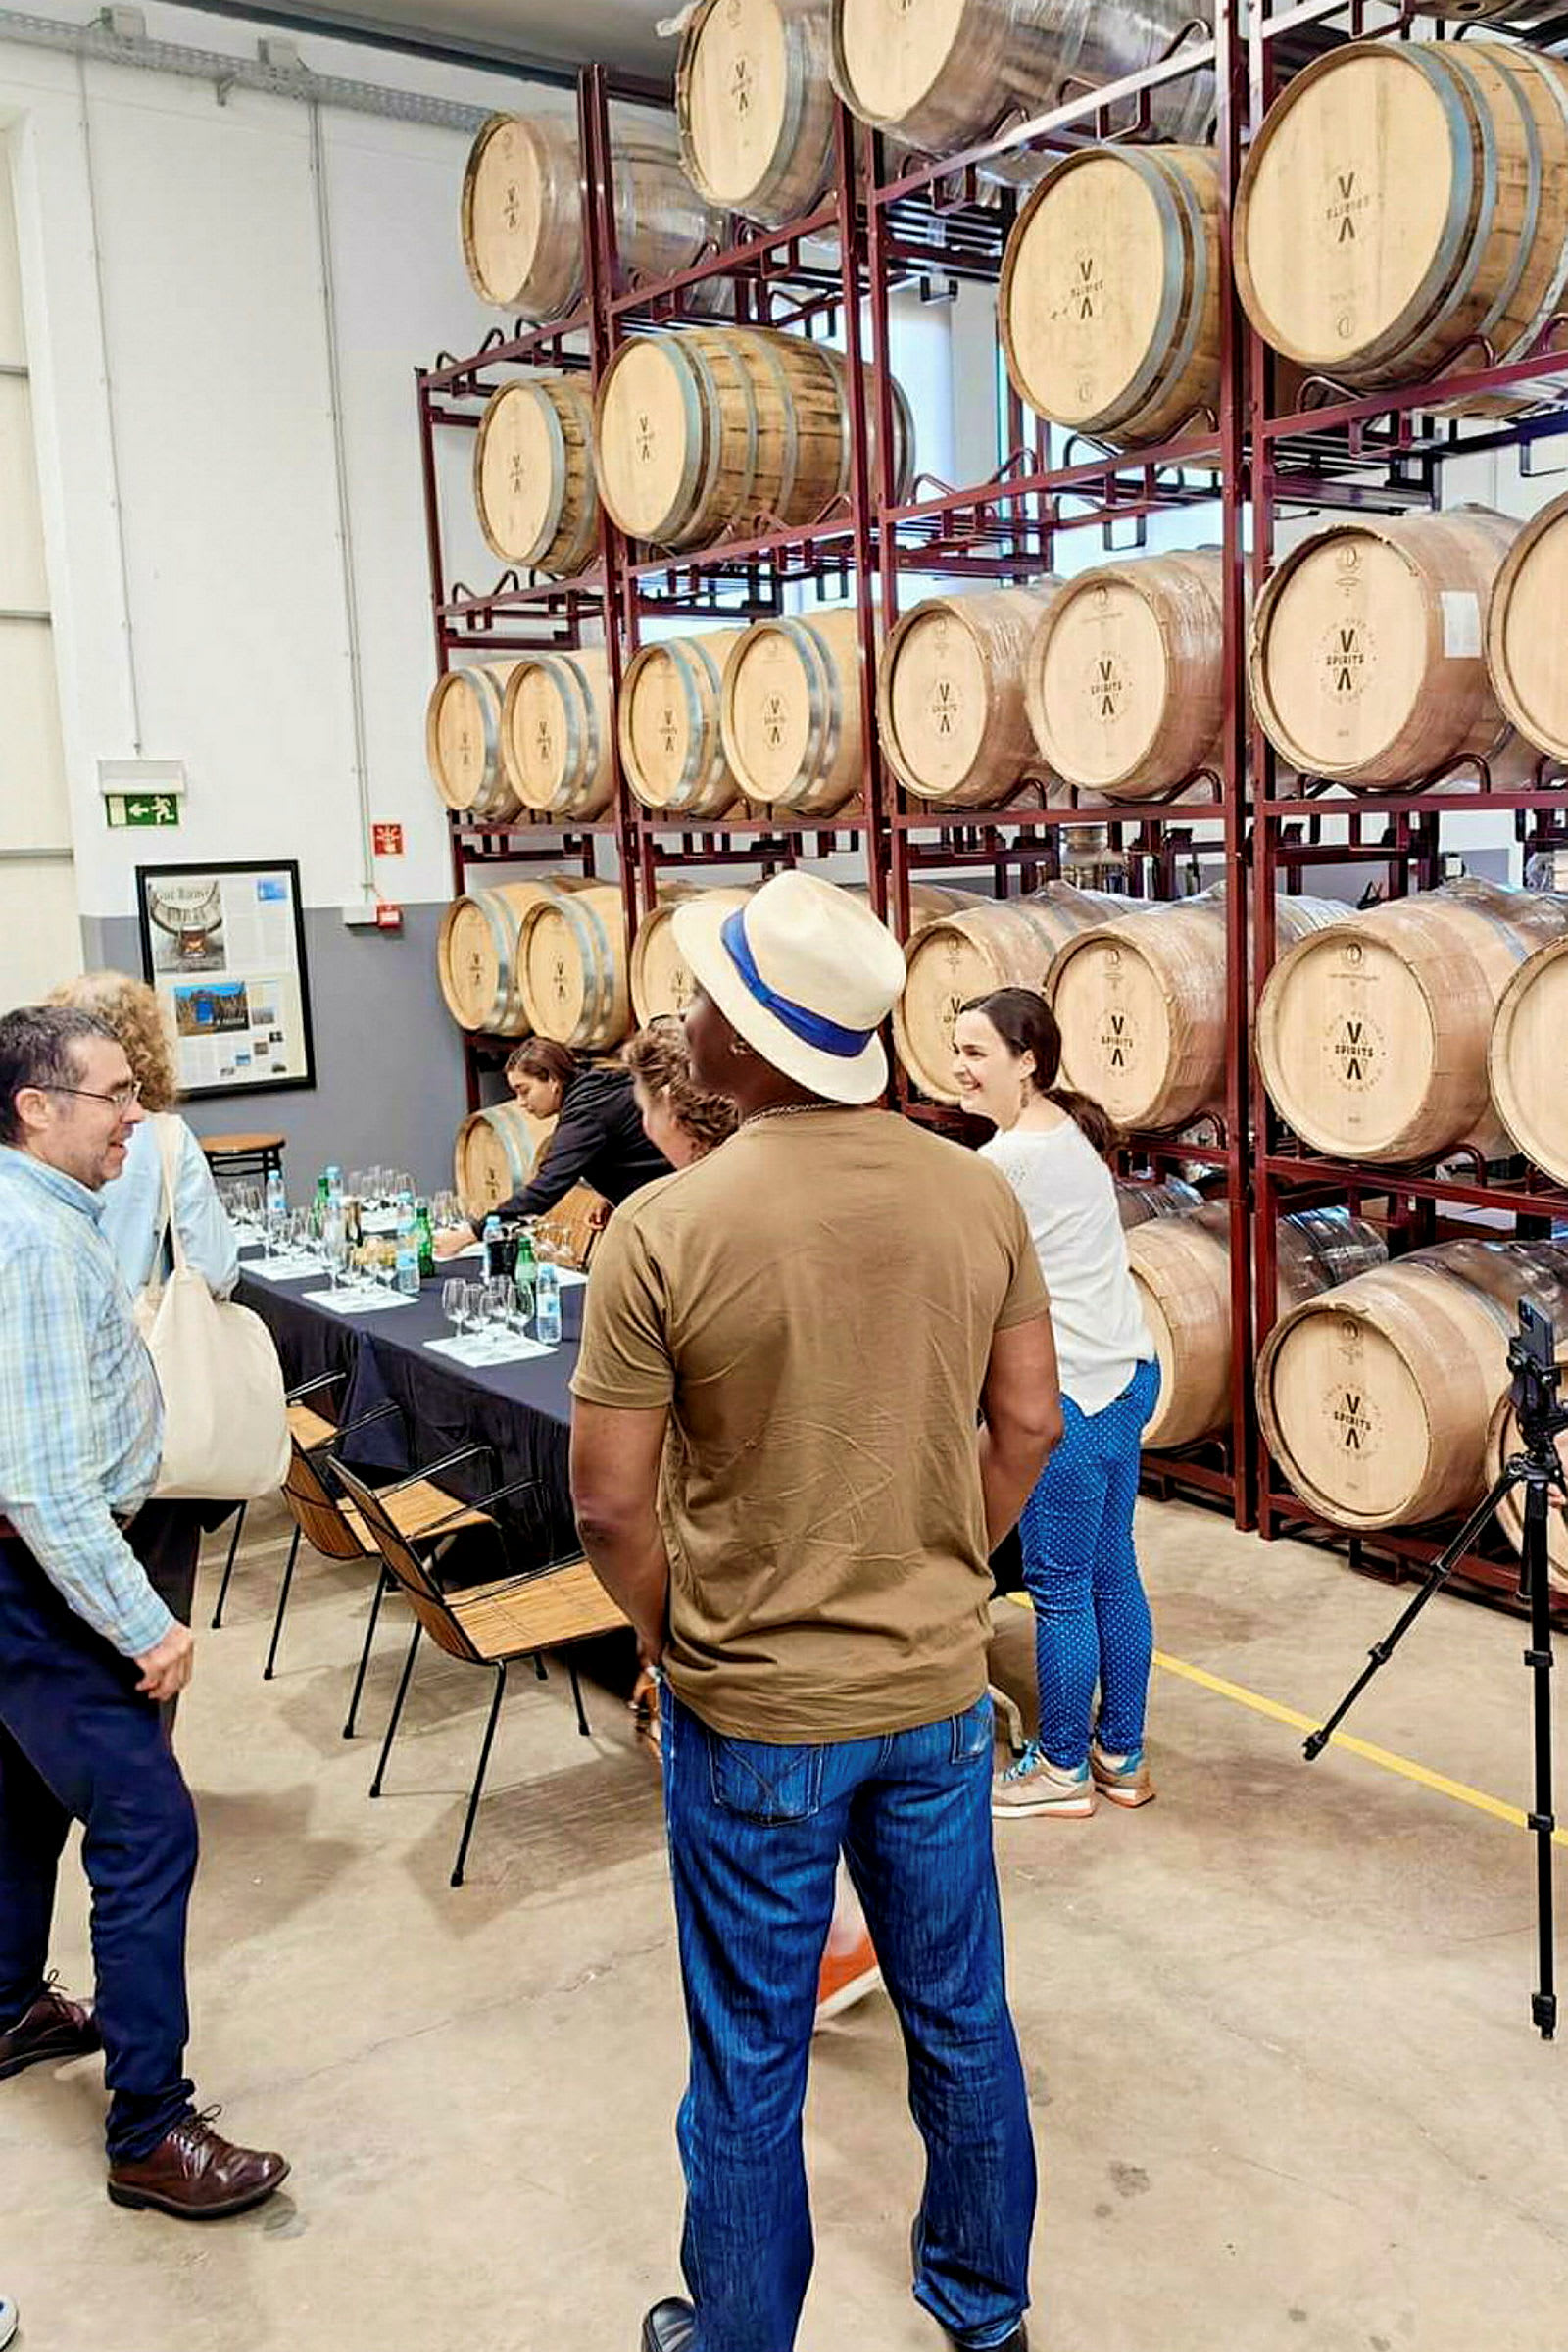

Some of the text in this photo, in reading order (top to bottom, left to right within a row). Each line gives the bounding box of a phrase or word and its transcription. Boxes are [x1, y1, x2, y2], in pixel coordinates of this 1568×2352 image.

[1341, 628, 1356, 654] V
[1100, 661, 1113, 681] V
[1111, 1015, 1125, 1036] V
[1347, 1021, 1362, 1044] V
[1101, 1035, 1134, 1049] SPIRITS
[1335, 1044, 1374, 1058] SPIRITS
[1346, 1393, 1361, 1415] V
[1334, 1411, 1372, 1431] SPIRITS
